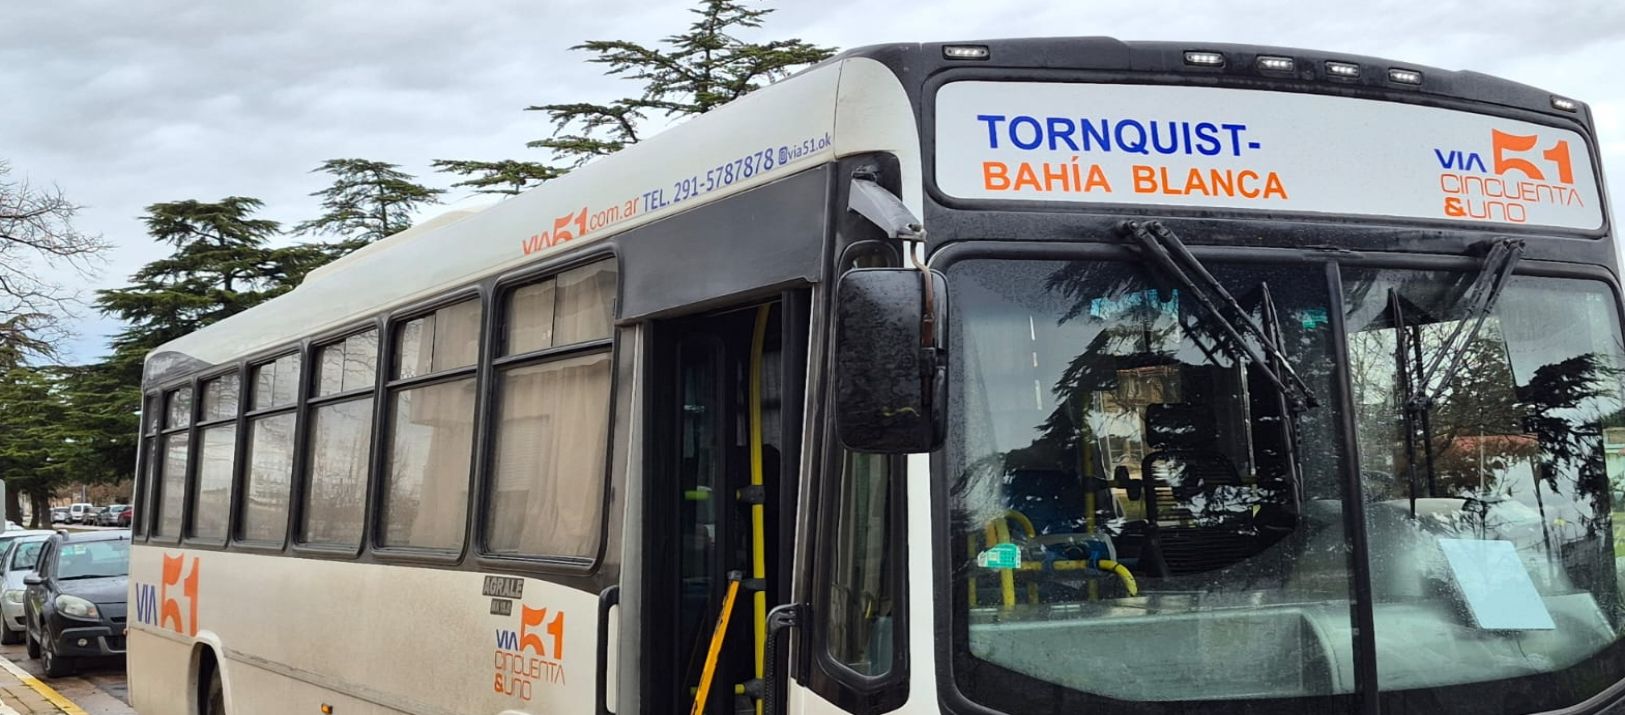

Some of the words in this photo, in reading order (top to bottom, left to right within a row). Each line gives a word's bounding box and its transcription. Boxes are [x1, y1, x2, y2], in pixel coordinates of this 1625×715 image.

[977, 114, 1261, 156] TORNQUIST-
[1433, 148, 1488, 173] VIA
[1491, 128, 1574, 185] 51
[643, 188, 670, 212] TEL.
[674, 148, 774, 203] 291-5787878
[982, 156, 1112, 193] BAHÍA
[1131, 164, 1289, 200] BLANCA
[1440, 173, 1584, 208] CINCUENTA
[135, 582, 158, 626] VIA
[160, 552, 200, 638] 51
[483, 576, 524, 598] AGRALE
[496, 629, 519, 651] VIA
[519, 603, 565, 661] 51
